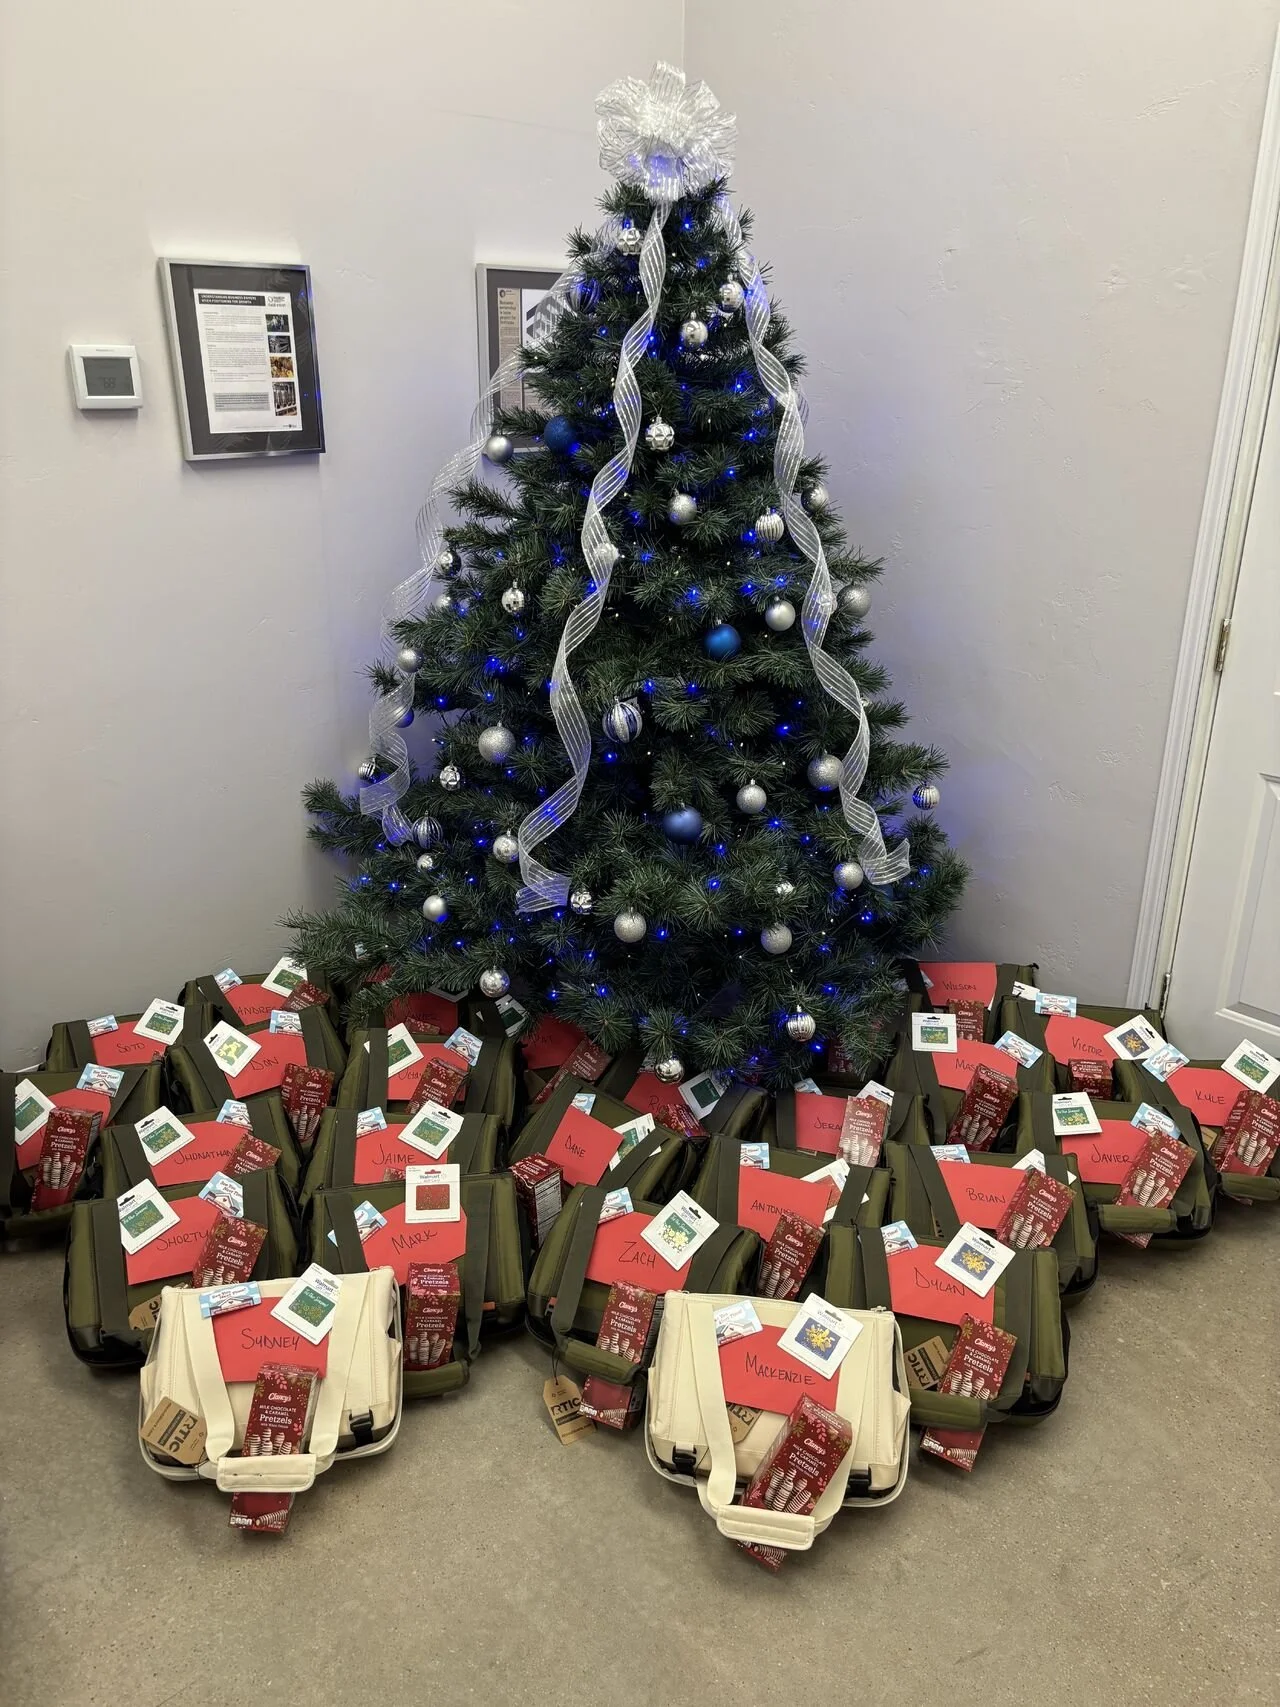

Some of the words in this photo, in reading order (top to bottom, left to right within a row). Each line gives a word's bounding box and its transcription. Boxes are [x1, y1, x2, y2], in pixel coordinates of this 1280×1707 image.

[238, 1006, 276, 1015] ANDRE
[1072, 1036, 1104, 1056] VICTOR
[1195, 1089, 1226, 1105] KYLE
[372, 1143, 416, 1165] JAIME
[1091, 1144, 1133, 1164] JAVIER
[1149, 1158, 1174, 1176] Pretzels
[966, 1188, 1006, 1204] BRIAN
[1027, 1201, 1052, 1220] Pretzels
[391, 1230, 438, 1255] MARK
[216, 1252, 244, 1266] Pretzels
[618, 1240, 656, 1269] ZACH
[774, 1248, 800, 1265] Pretzels
[914, 1267, 966, 1296] DYLAN
[241, 1328, 300, 1350] SYDNEY
[745, 1352, 816, 1386] MACKENZIE
[908, 1352, 930, 1387] RTIC
[964, 1355, 994, 1373] Pretzels
[550, 1398, 580, 1415] RTIC
[260, 1414, 292, 1424] Pretzels
[169, 1415, 198, 1452] RTIC
[789, 1452, 819, 1476] Pretzels
